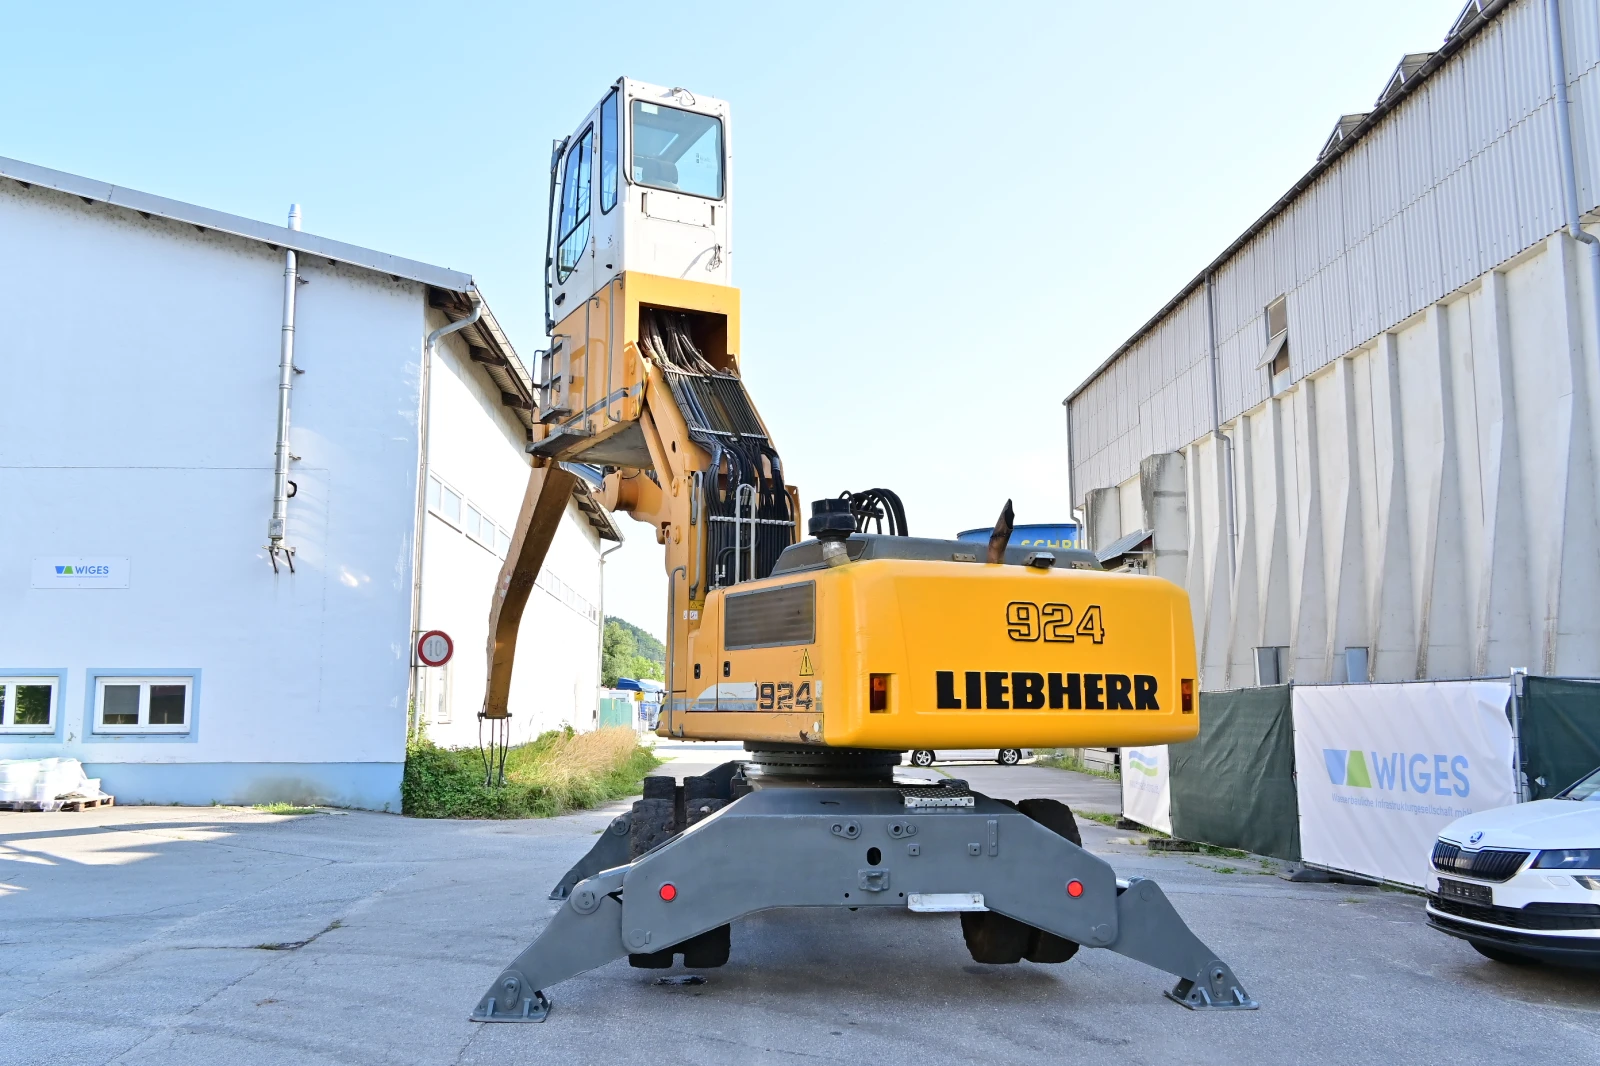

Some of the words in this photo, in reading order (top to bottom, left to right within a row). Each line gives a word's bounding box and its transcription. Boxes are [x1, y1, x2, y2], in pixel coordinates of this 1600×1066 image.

[75, 565, 109, 575] WIGES
[1006, 601, 1105, 644] 924
[427, 640, 442, 657] 10
[760, 680, 813, 711] 924
[936, 670, 1160, 711] LIEBHERR
[1371, 751, 1470, 798] WIGES
